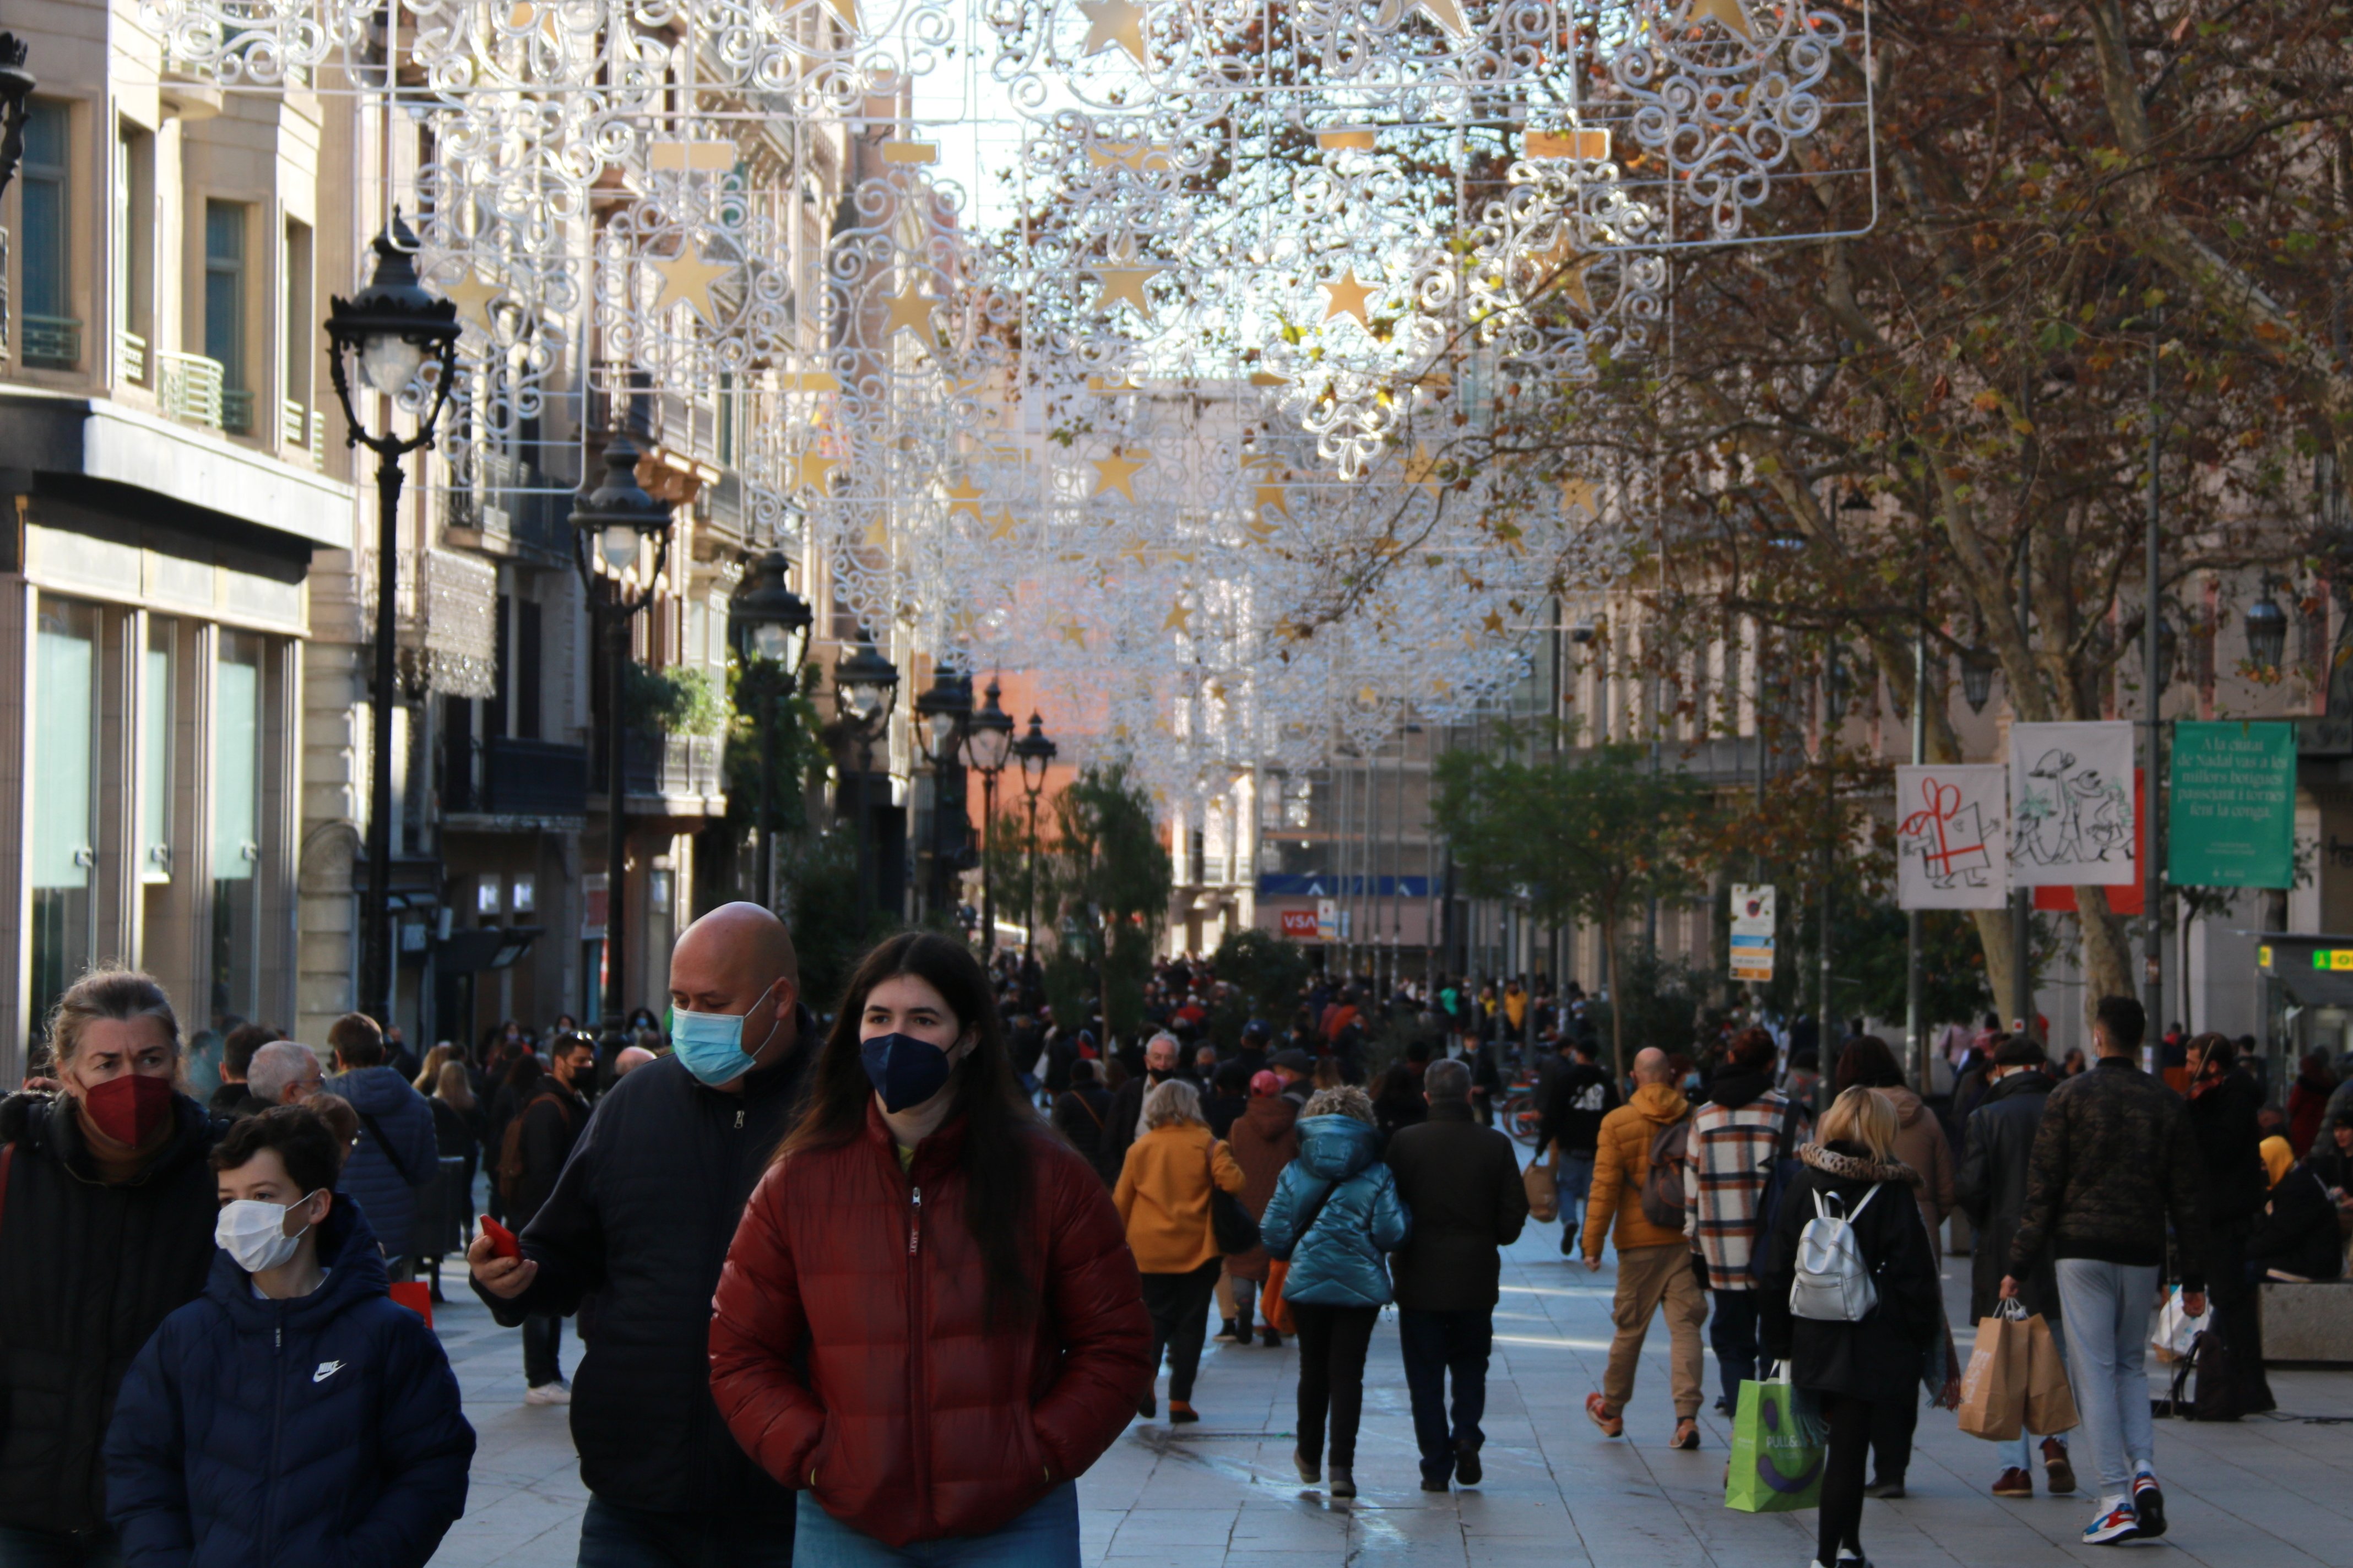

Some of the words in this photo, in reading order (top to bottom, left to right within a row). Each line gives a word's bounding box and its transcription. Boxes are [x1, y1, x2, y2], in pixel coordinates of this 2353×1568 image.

[2202, 737, 2212, 750] A
[2214, 736, 2226, 751] la
[2177, 752, 2192, 767] de
[2196, 753, 2233, 767] Nadal
[2182, 769, 2227, 783] millors
[2230, 771, 2283, 788] botigues
[2190, 802, 2213, 816] fent
[2217, 802, 2229, 816] la
[317, 1359, 339, 1374] NIKE
